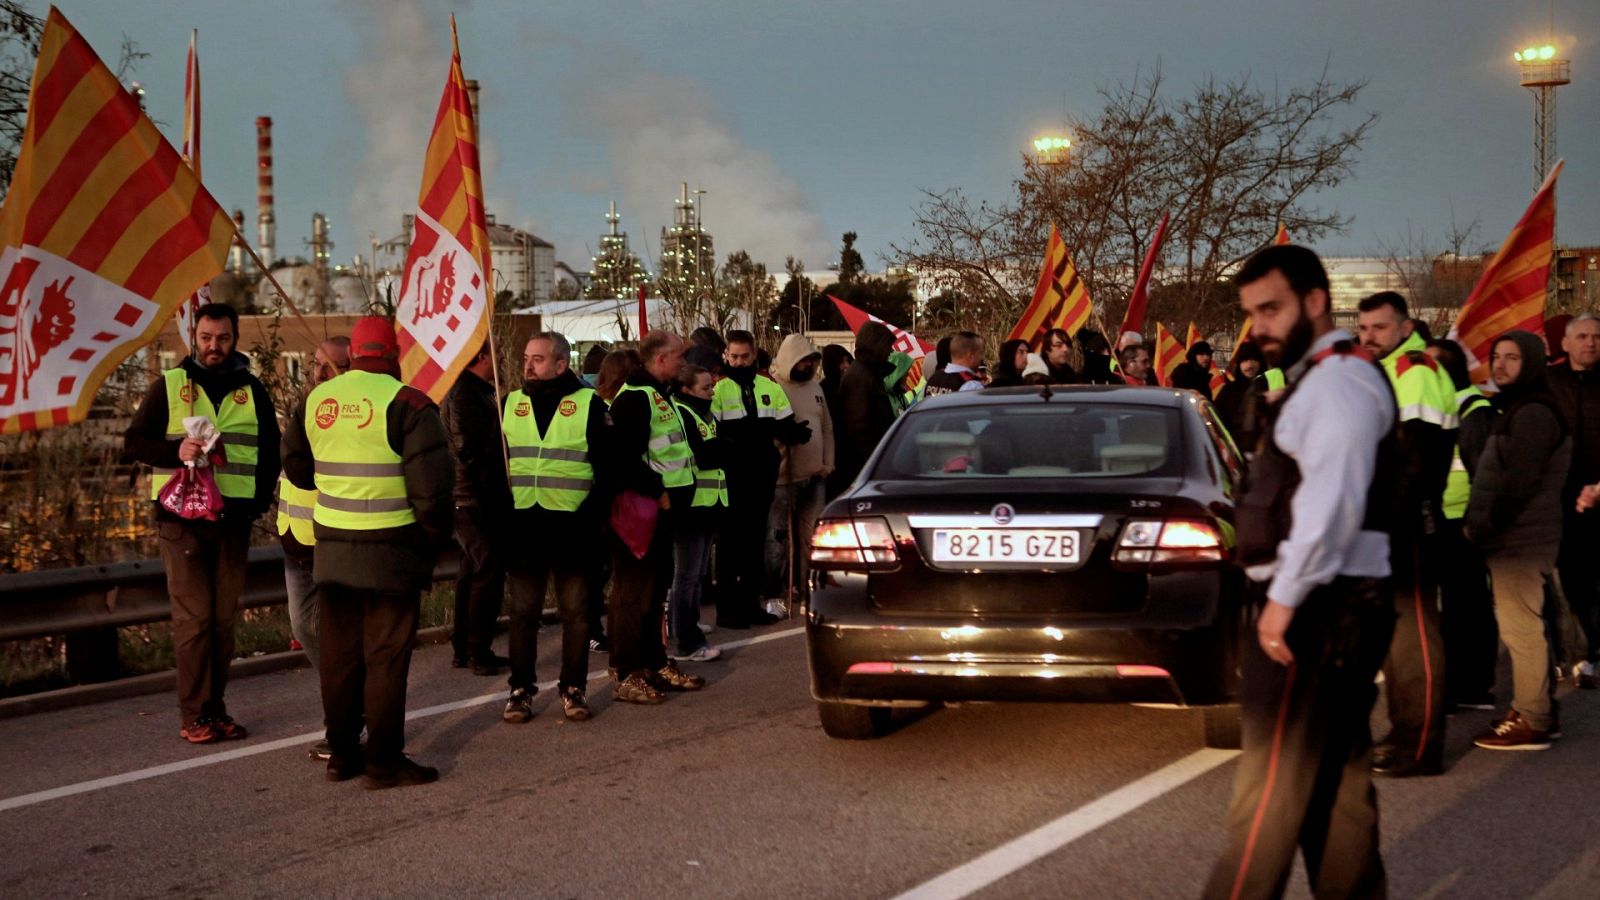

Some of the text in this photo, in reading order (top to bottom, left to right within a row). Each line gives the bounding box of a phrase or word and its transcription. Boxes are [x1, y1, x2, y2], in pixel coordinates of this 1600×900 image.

[341, 404, 360, 414] FICA
[950, 534, 1075, 558] 8215 GZB
